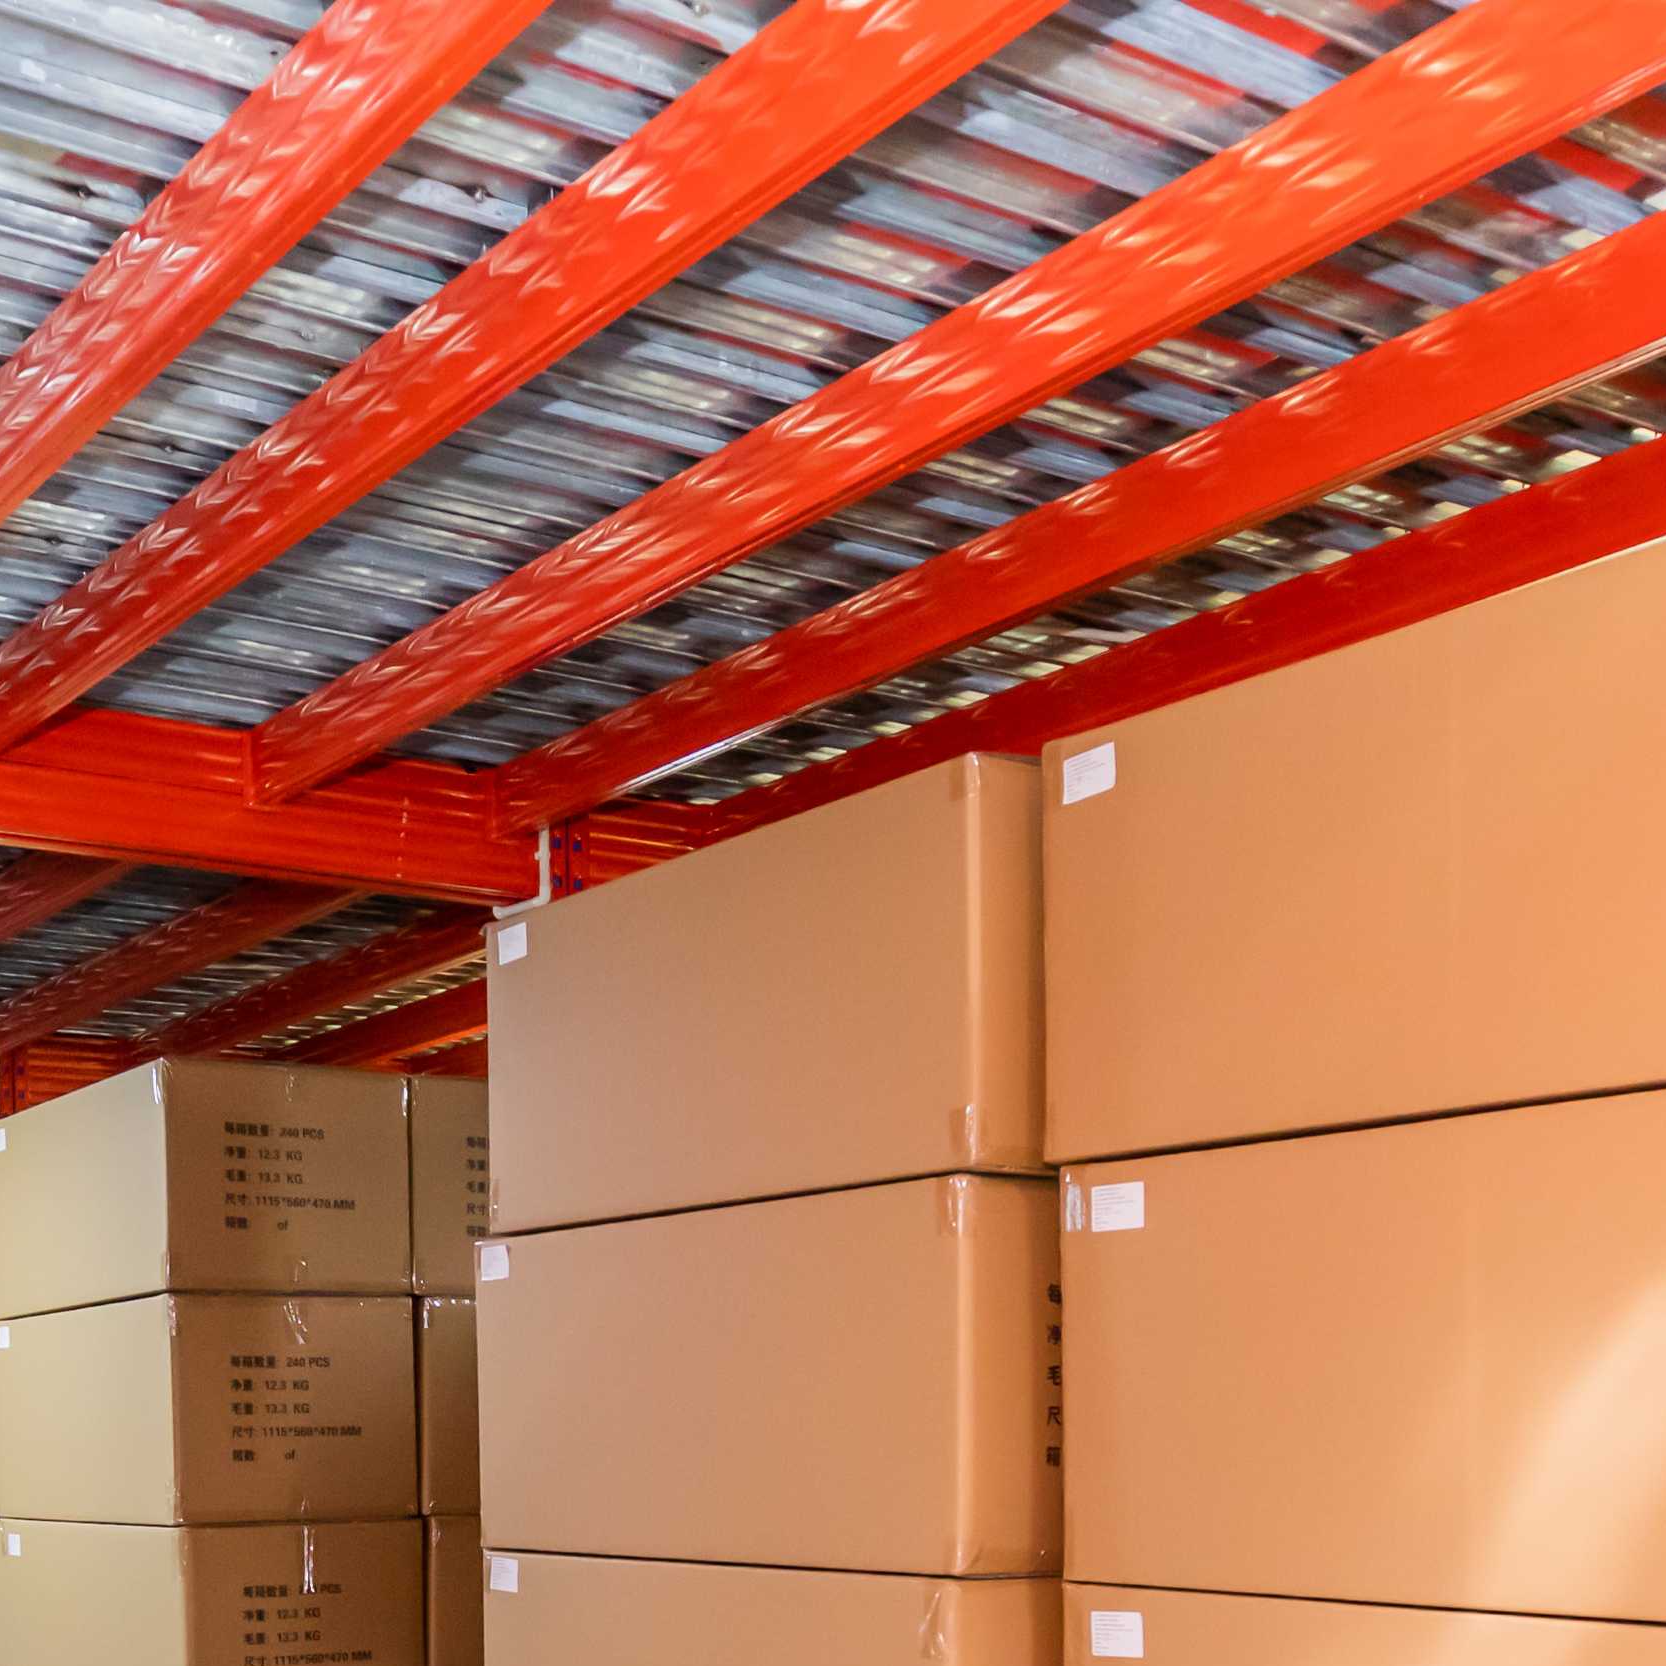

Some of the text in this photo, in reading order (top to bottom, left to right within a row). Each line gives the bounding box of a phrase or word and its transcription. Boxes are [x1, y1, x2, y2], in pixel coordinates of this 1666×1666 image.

[302, 1128, 325, 1140] PCS
[286, 1150, 302, 1161] KG
[286, 1173, 303, 1184] KG
[277, 1220, 289, 1231] of
[309, 1357, 330, 1368] PCS
[1047, 1366, 1061, 1386] 毛
[292, 1380, 309, 1391] KG
[293, 1403, 310, 1414] KG
[1047, 1406, 1061, 1425] 尺
[284, 1449, 295, 1460] of
[305, 1607, 321, 1618] KG
[305, 1631, 321, 1642] KG
